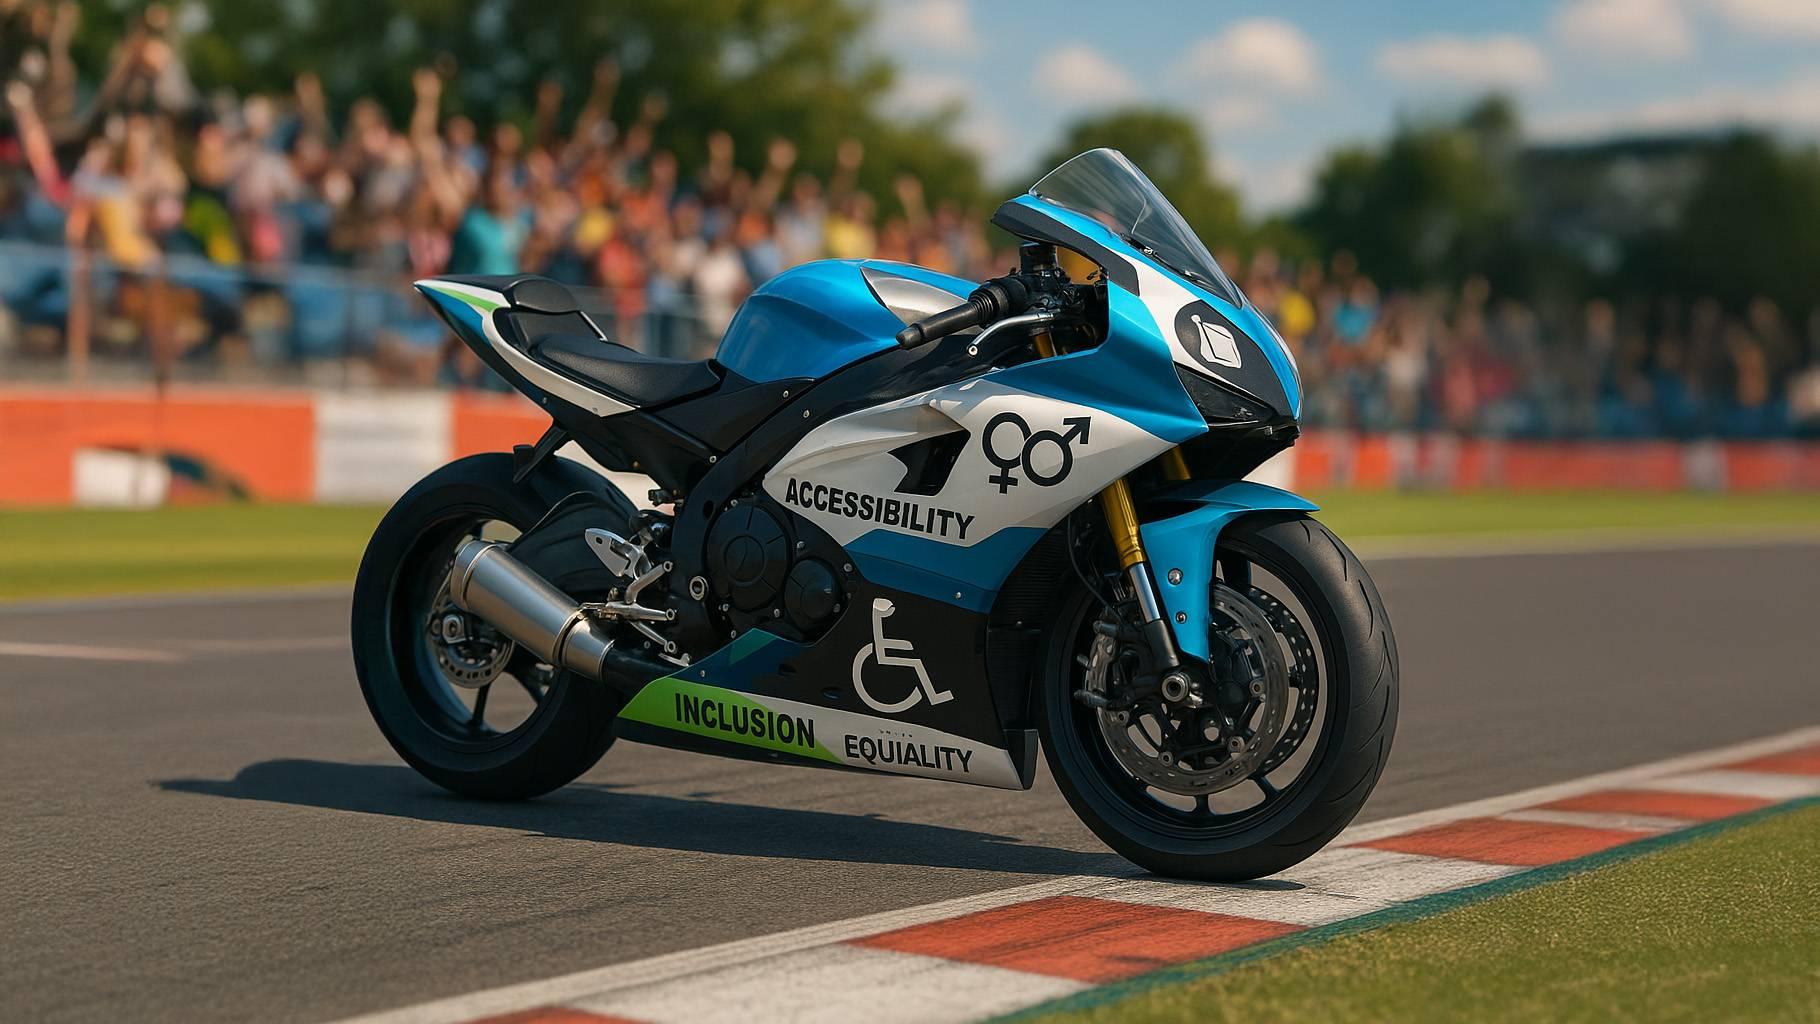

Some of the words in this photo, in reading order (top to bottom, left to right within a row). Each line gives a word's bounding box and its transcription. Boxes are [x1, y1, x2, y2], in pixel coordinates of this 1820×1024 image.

[785, 477, 975, 540] ACCESSIBILITY
[675, 692, 815, 748] INCLUSION
[844, 734, 972, 773] EQUIALITY
